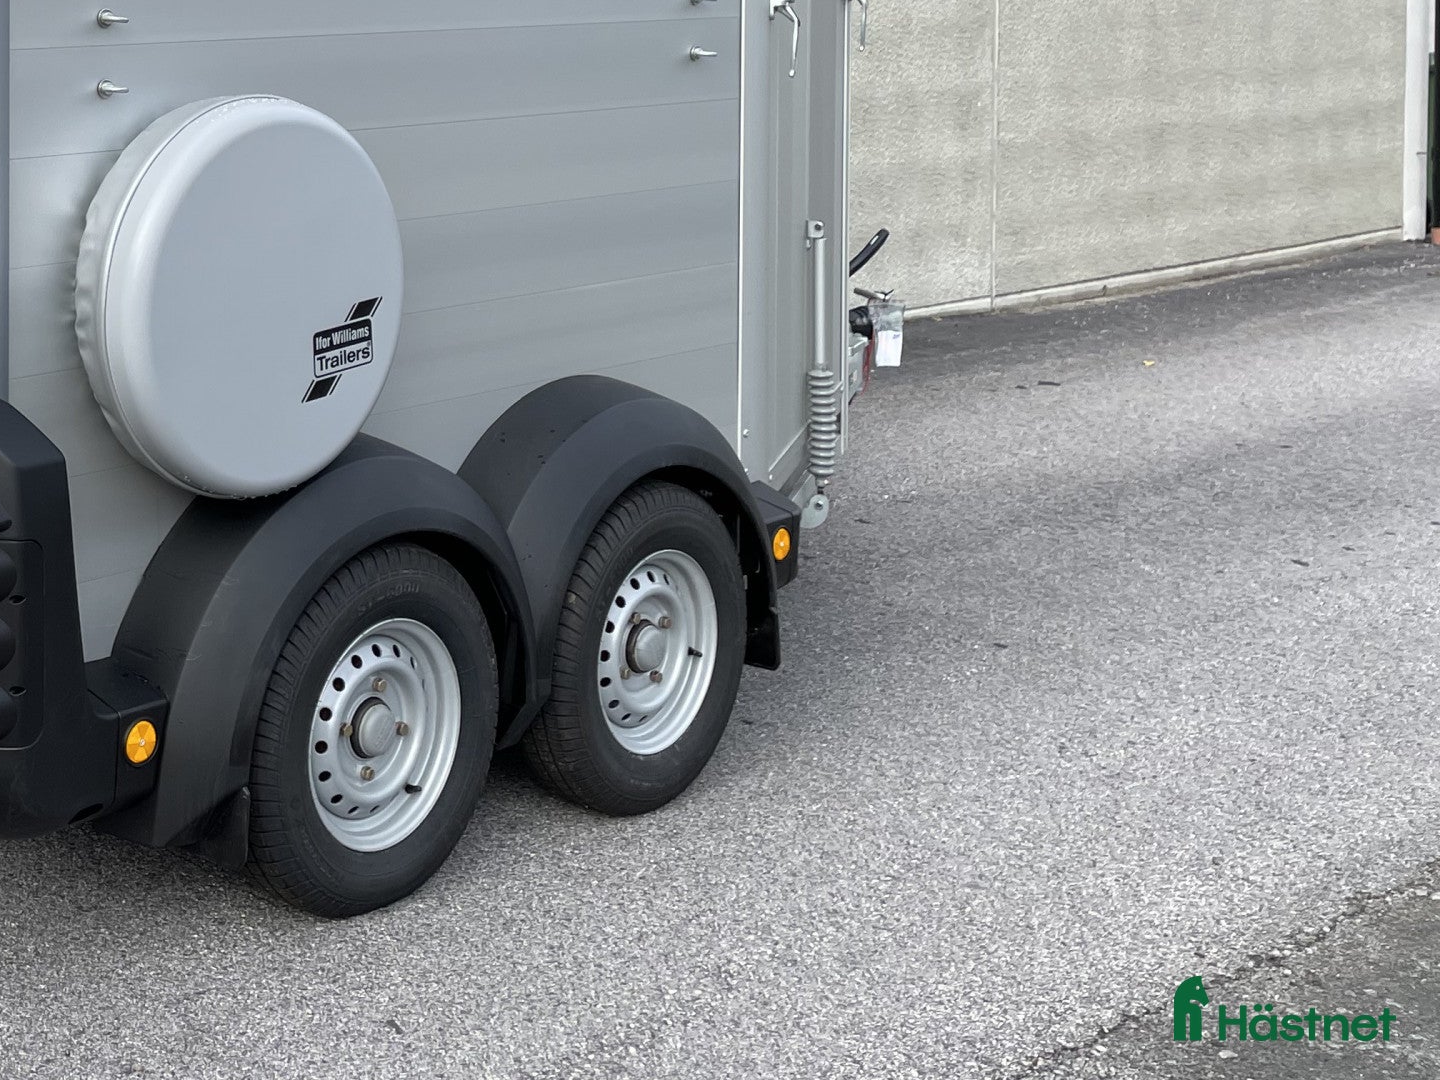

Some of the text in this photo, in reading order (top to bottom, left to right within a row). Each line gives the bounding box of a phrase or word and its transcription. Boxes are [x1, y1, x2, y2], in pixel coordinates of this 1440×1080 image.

[315, 326, 370, 350] Ifor Williams
[316, 346, 371, 371] Trailers
